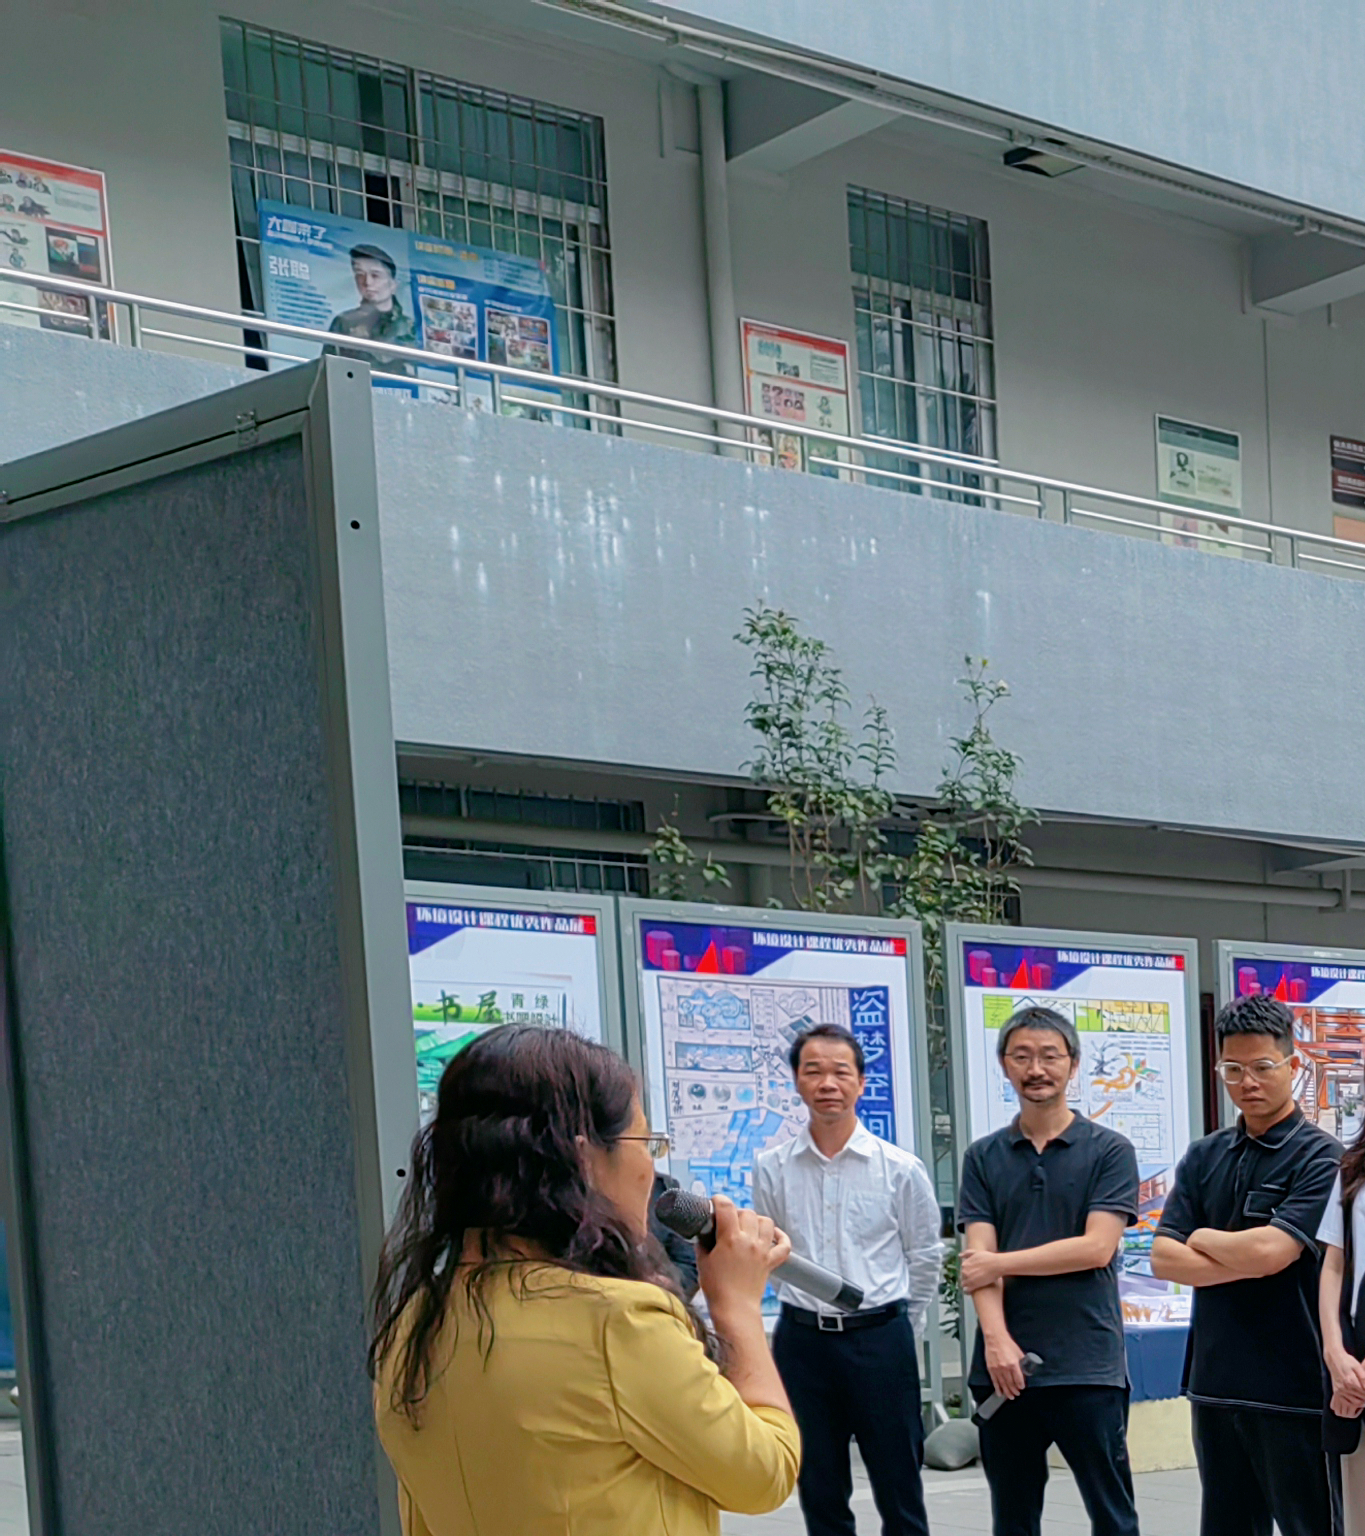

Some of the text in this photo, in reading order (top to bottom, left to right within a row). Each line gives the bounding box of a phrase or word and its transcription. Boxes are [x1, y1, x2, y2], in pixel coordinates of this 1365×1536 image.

[415, 906, 584, 933] 环境设计课程优秀作品展
[752, 931, 895, 954] 环境设计课程优秀作品展
[1057, 950, 1176, 969] 环境设计课程优秀作品展
[852, 990, 893, 1143] 盗梦空间
